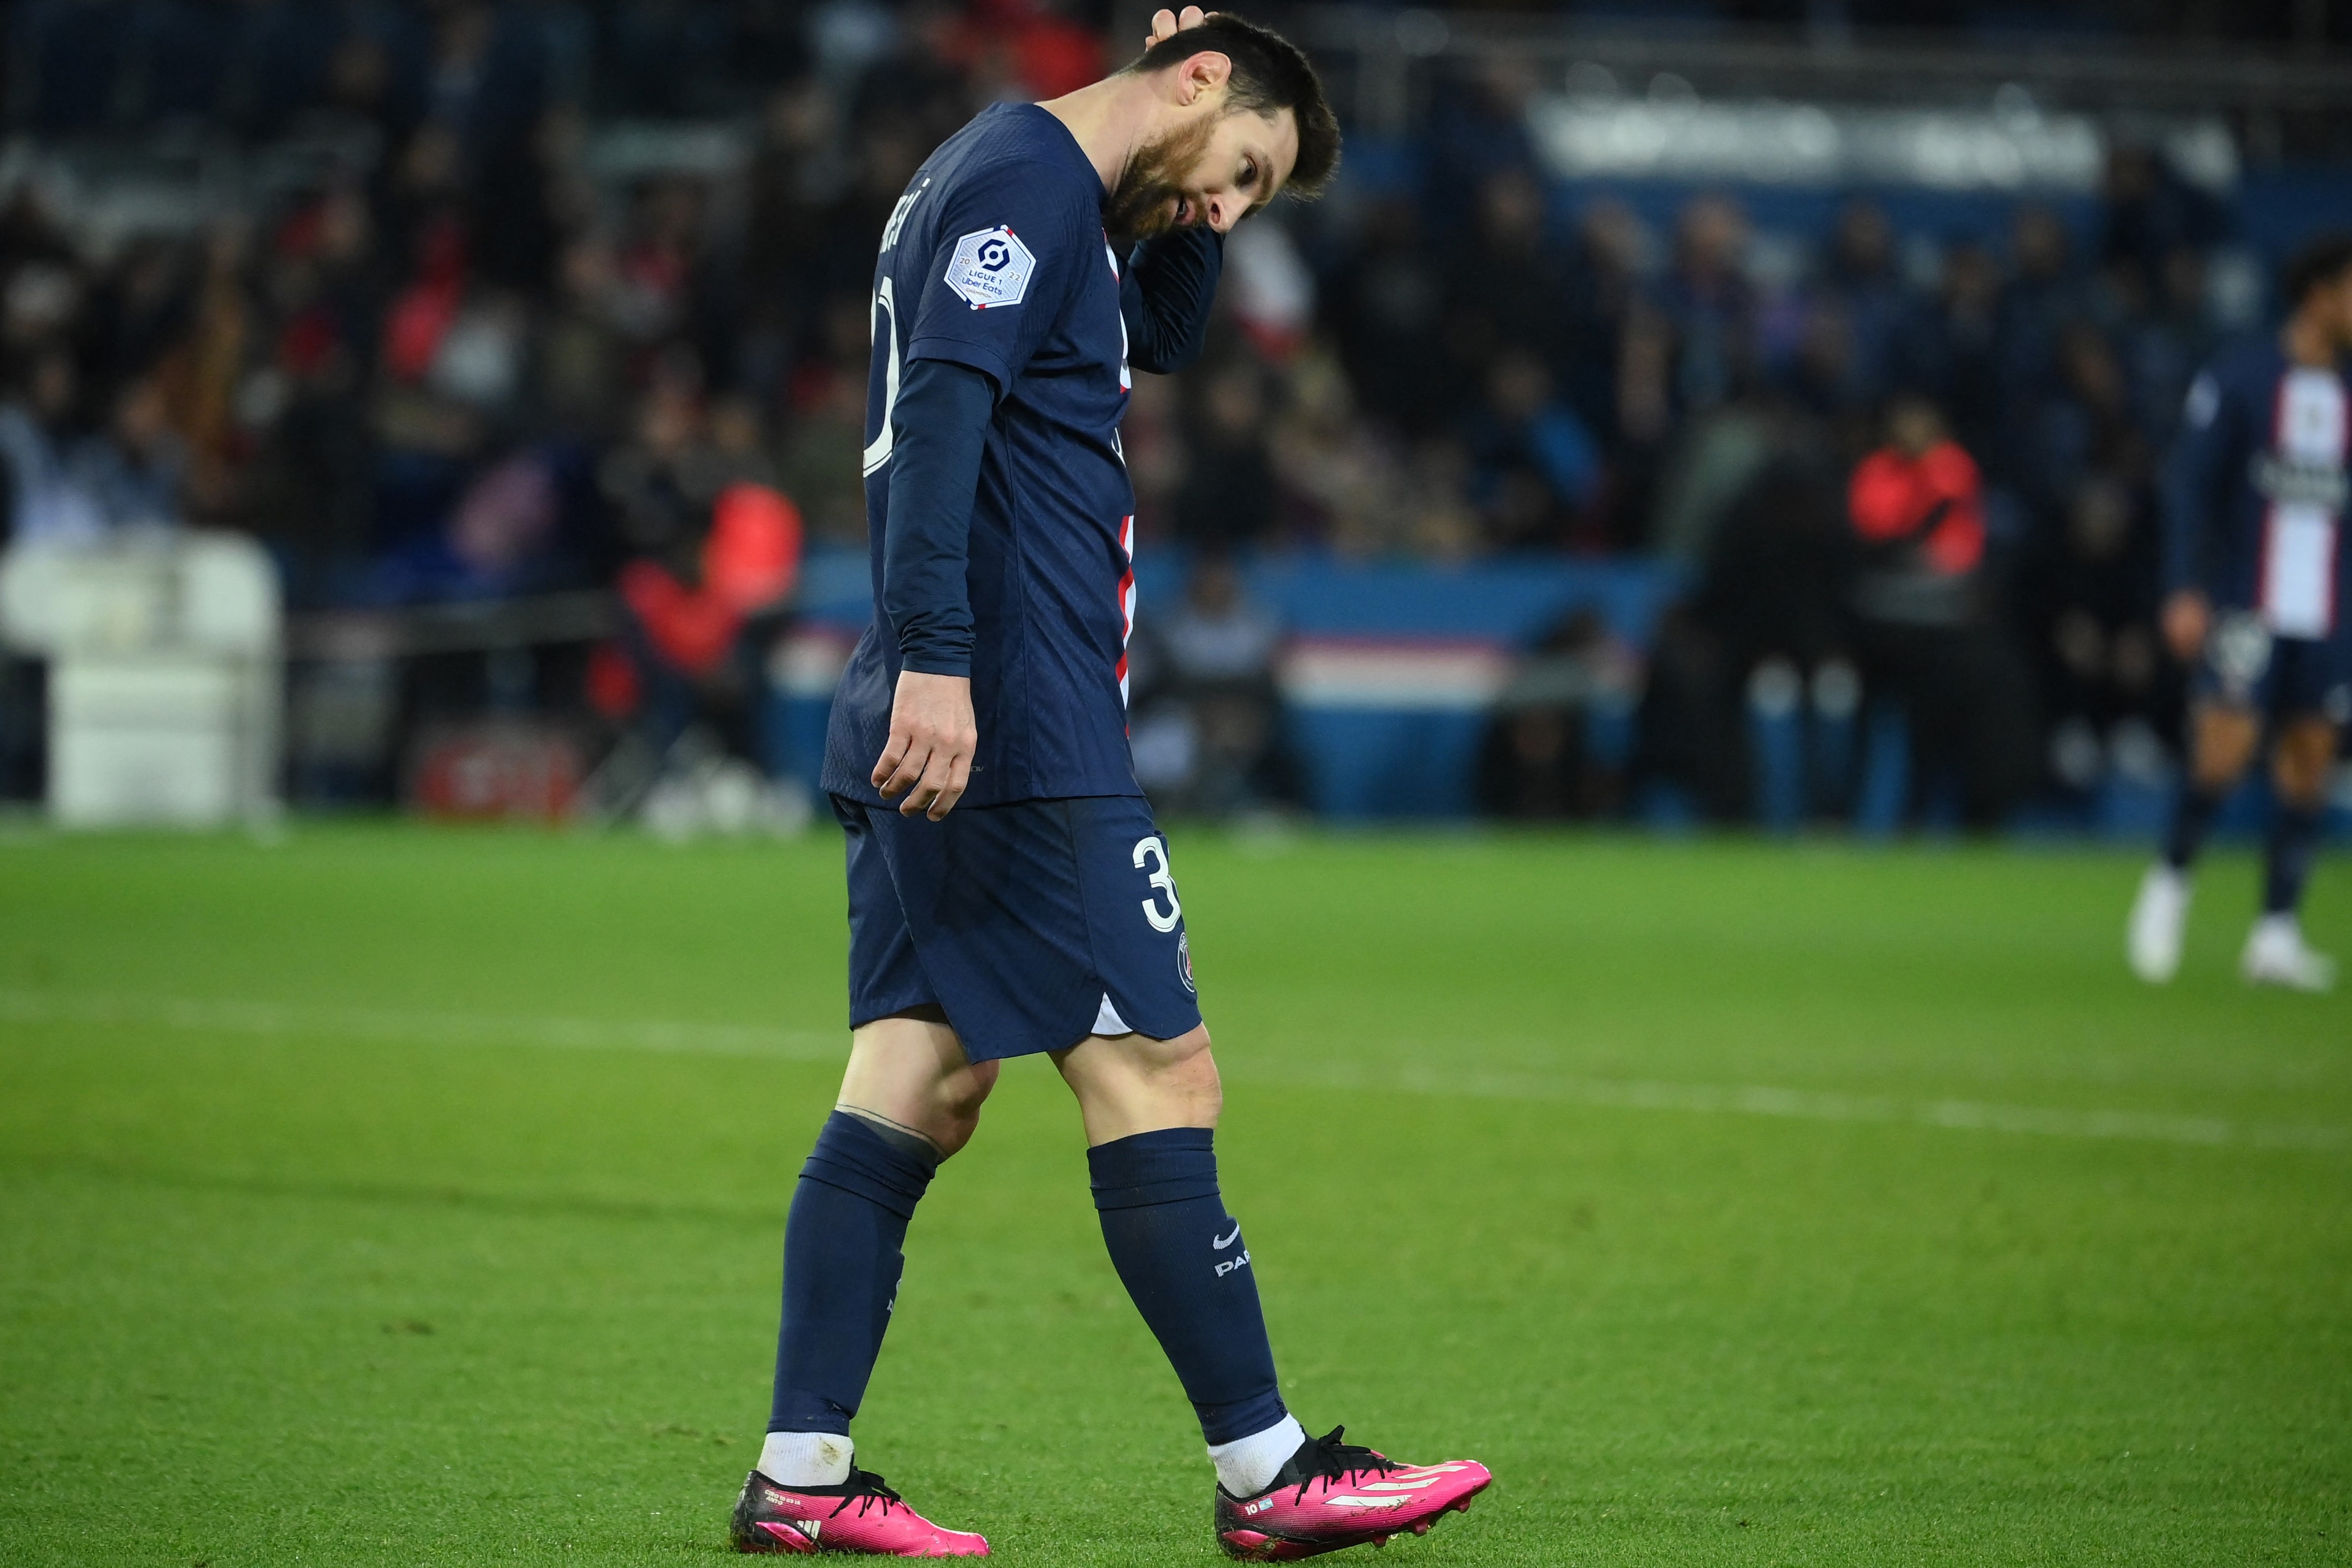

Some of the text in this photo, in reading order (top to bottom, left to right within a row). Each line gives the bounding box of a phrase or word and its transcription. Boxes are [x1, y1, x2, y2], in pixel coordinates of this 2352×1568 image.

[969, 270, 996, 283] LIGUE
[1009, 271, 1020, 281] 22
[961, 277, 1003, 296] Uber Eats
[966, 288, 992, 298] CHAMPION
[1132, 836, 1181, 933] 3
[766, 1496, 783, 1505] ANTO
[1244, 1504, 1258, 1516] 10
